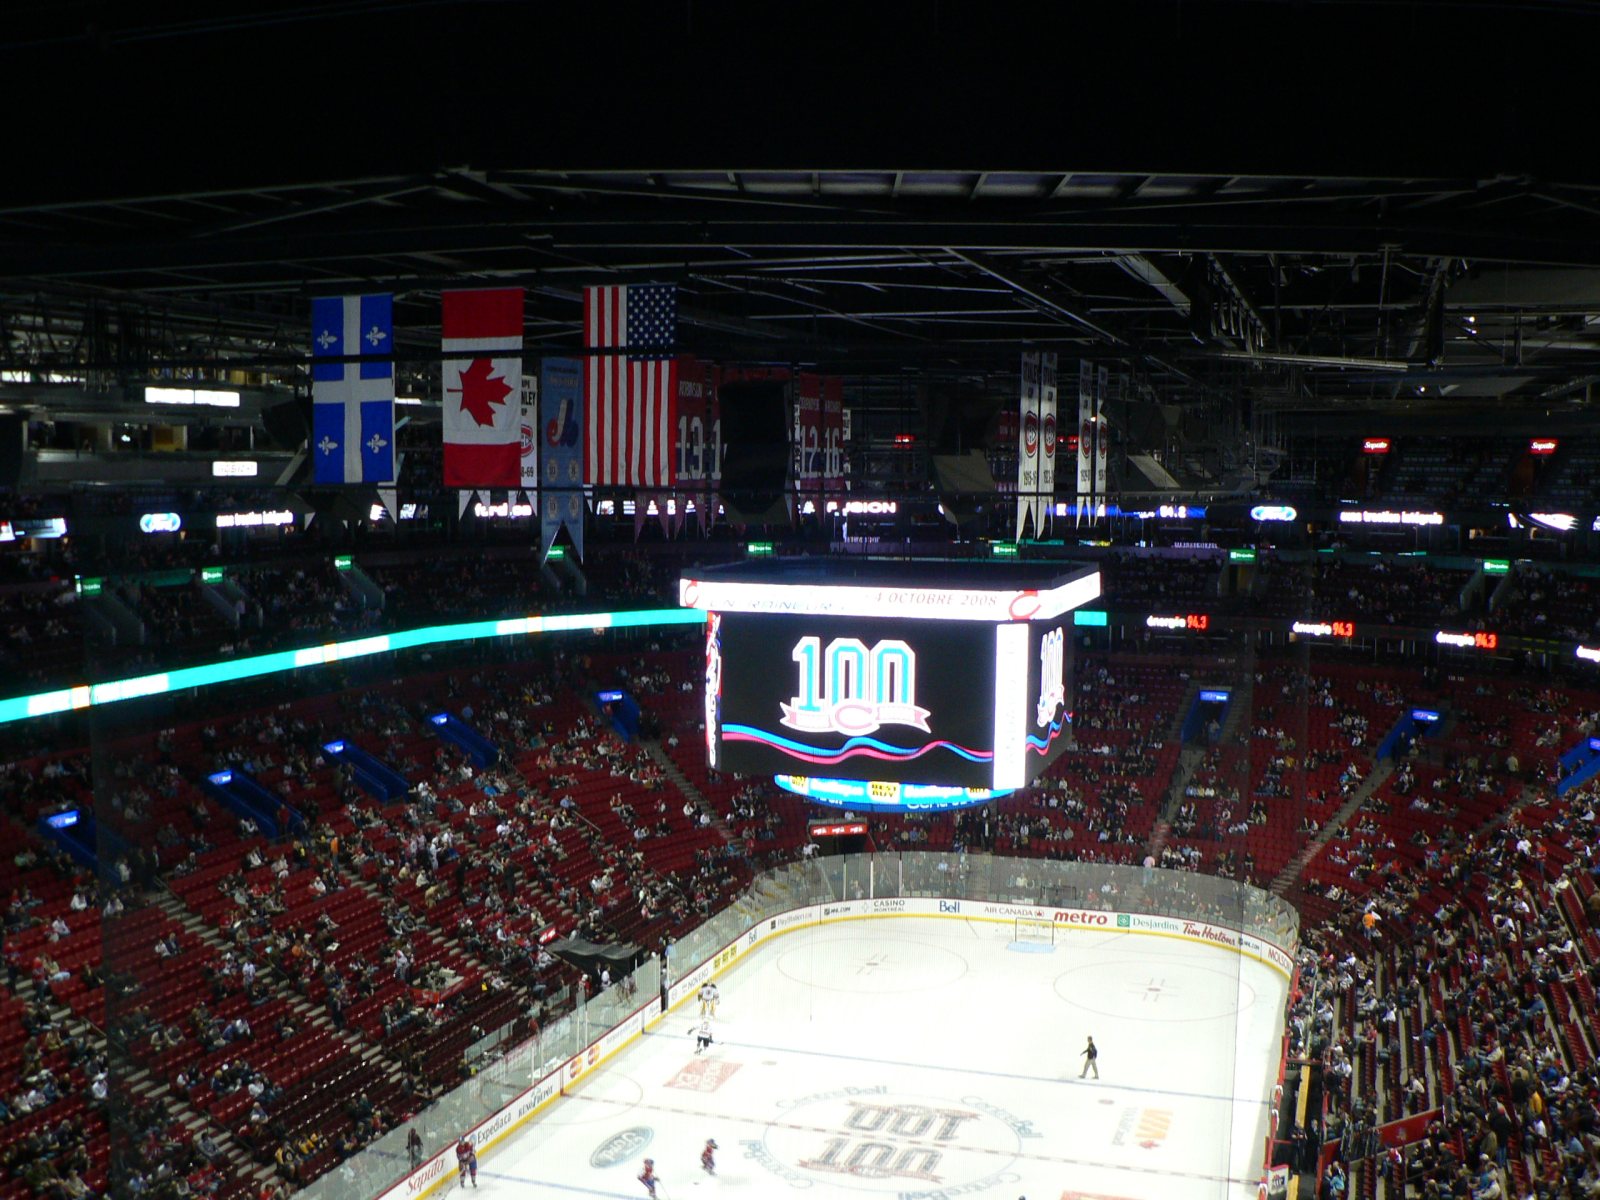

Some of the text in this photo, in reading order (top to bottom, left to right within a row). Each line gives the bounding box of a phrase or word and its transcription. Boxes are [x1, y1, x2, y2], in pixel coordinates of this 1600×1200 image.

[521, 392, 535, 405] NLEY
[1364, 440, 1388, 450] Saputo
[1531, 440, 1556, 450] Saputo
[824, 428, 842, 479] 16
[521, 467, 534, 477] 8-69
[888, 592, 952, 604] OCTOBRE
[960, 594, 997, 606] 2008
[1187, 614, 1207, 629] 94.3
[1332, 621, 1353, 636] 94.3
[1475, 633, 1496, 648] 94.3
[791, 636, 916, 713] 100
[872, 790, 894, 798] BUY
[874, 899, 905, 907] CASINO
[939, 901, 960, 913] Bell
[984, 906, 1033, 916] AIR CANADA
[1054, 911, 1108, 925] metro
[1132, 917, 1179, 931] Desjardins
[1183, 922, 1236, 945] Tim Hortons
[1267, 947, 1293, 972] MOLSON
[407, 1158, 445, 1195] Saputo
